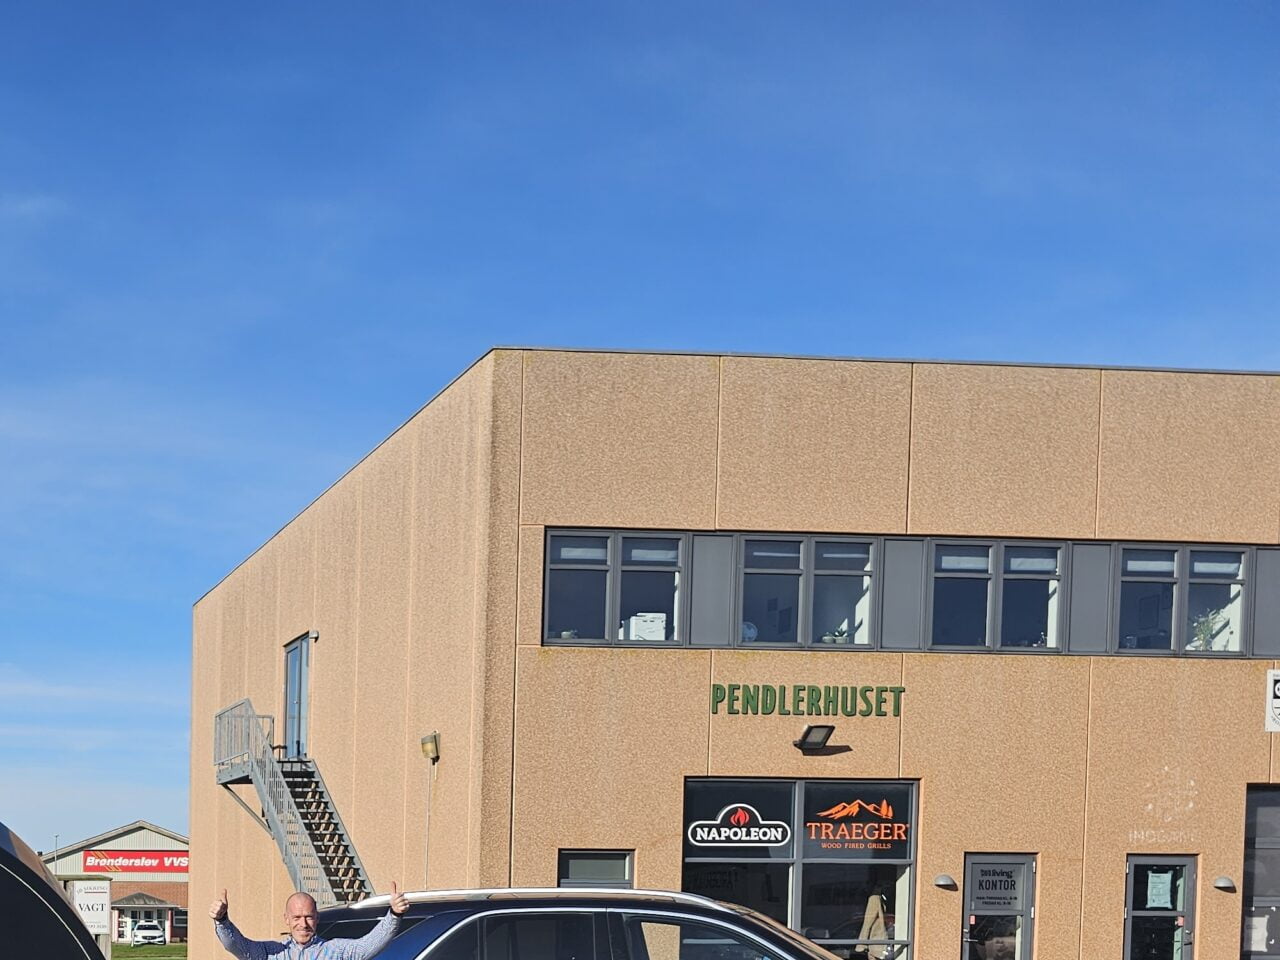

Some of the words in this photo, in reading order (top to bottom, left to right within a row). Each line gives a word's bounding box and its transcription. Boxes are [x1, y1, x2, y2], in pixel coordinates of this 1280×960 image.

[711, 683, 905, 717] PENDLERHUSET
[696, 828, 783, 841] NAPOLEON
[806, 822, 908, 841] TRAEGER
[86, 857, 159, 866] Brønderslev
[164, 857, 188, 866] VVS
[978, 880, 1016, 890] KONTOR
[78, 903, 107, 912] VAGT
